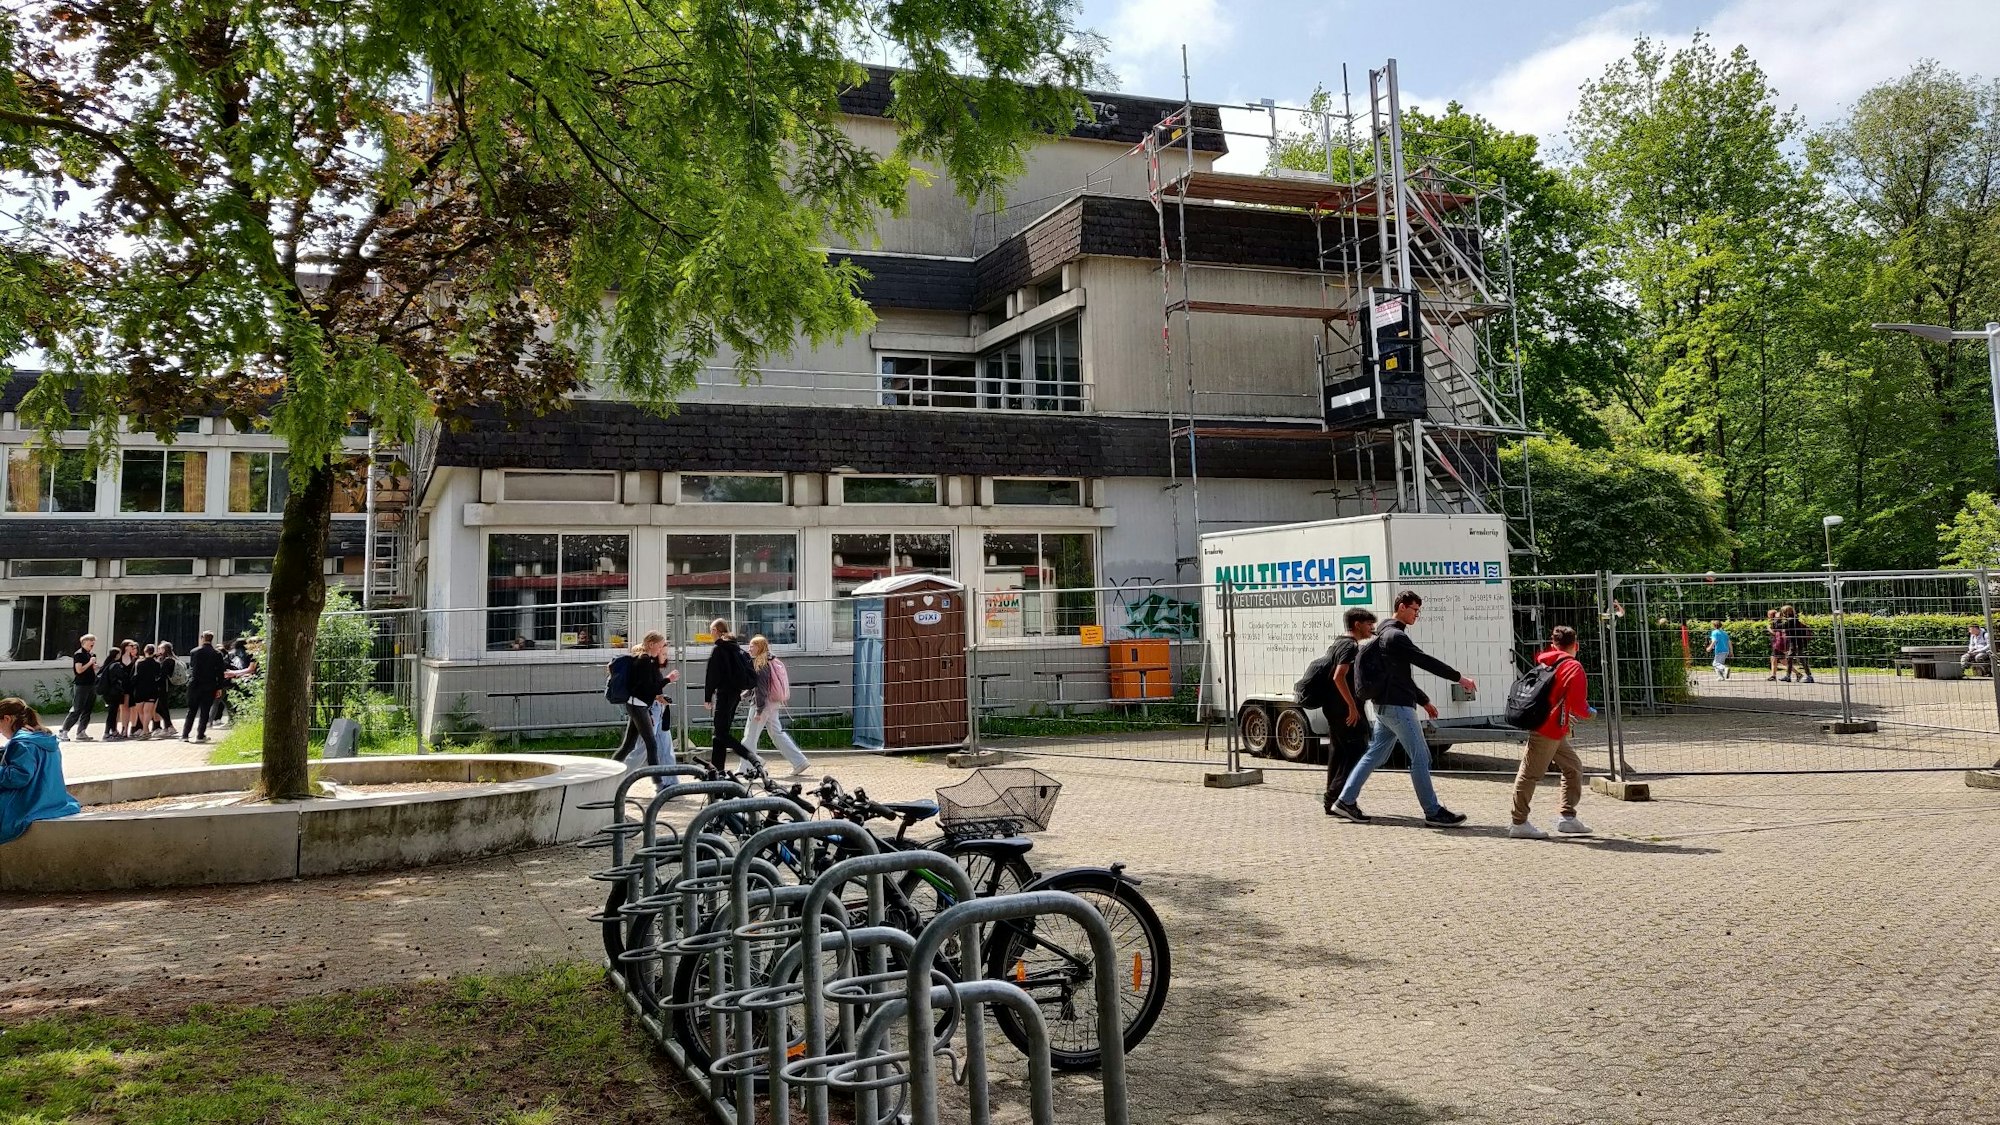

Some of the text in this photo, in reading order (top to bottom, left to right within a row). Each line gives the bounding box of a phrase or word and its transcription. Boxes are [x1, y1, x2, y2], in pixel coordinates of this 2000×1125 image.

[1216, 558, 1336, 591] MULTITECH
[1399, 561, 1480, 576] MULTITECH
[1302, 590, 1335, 605] GMBH
